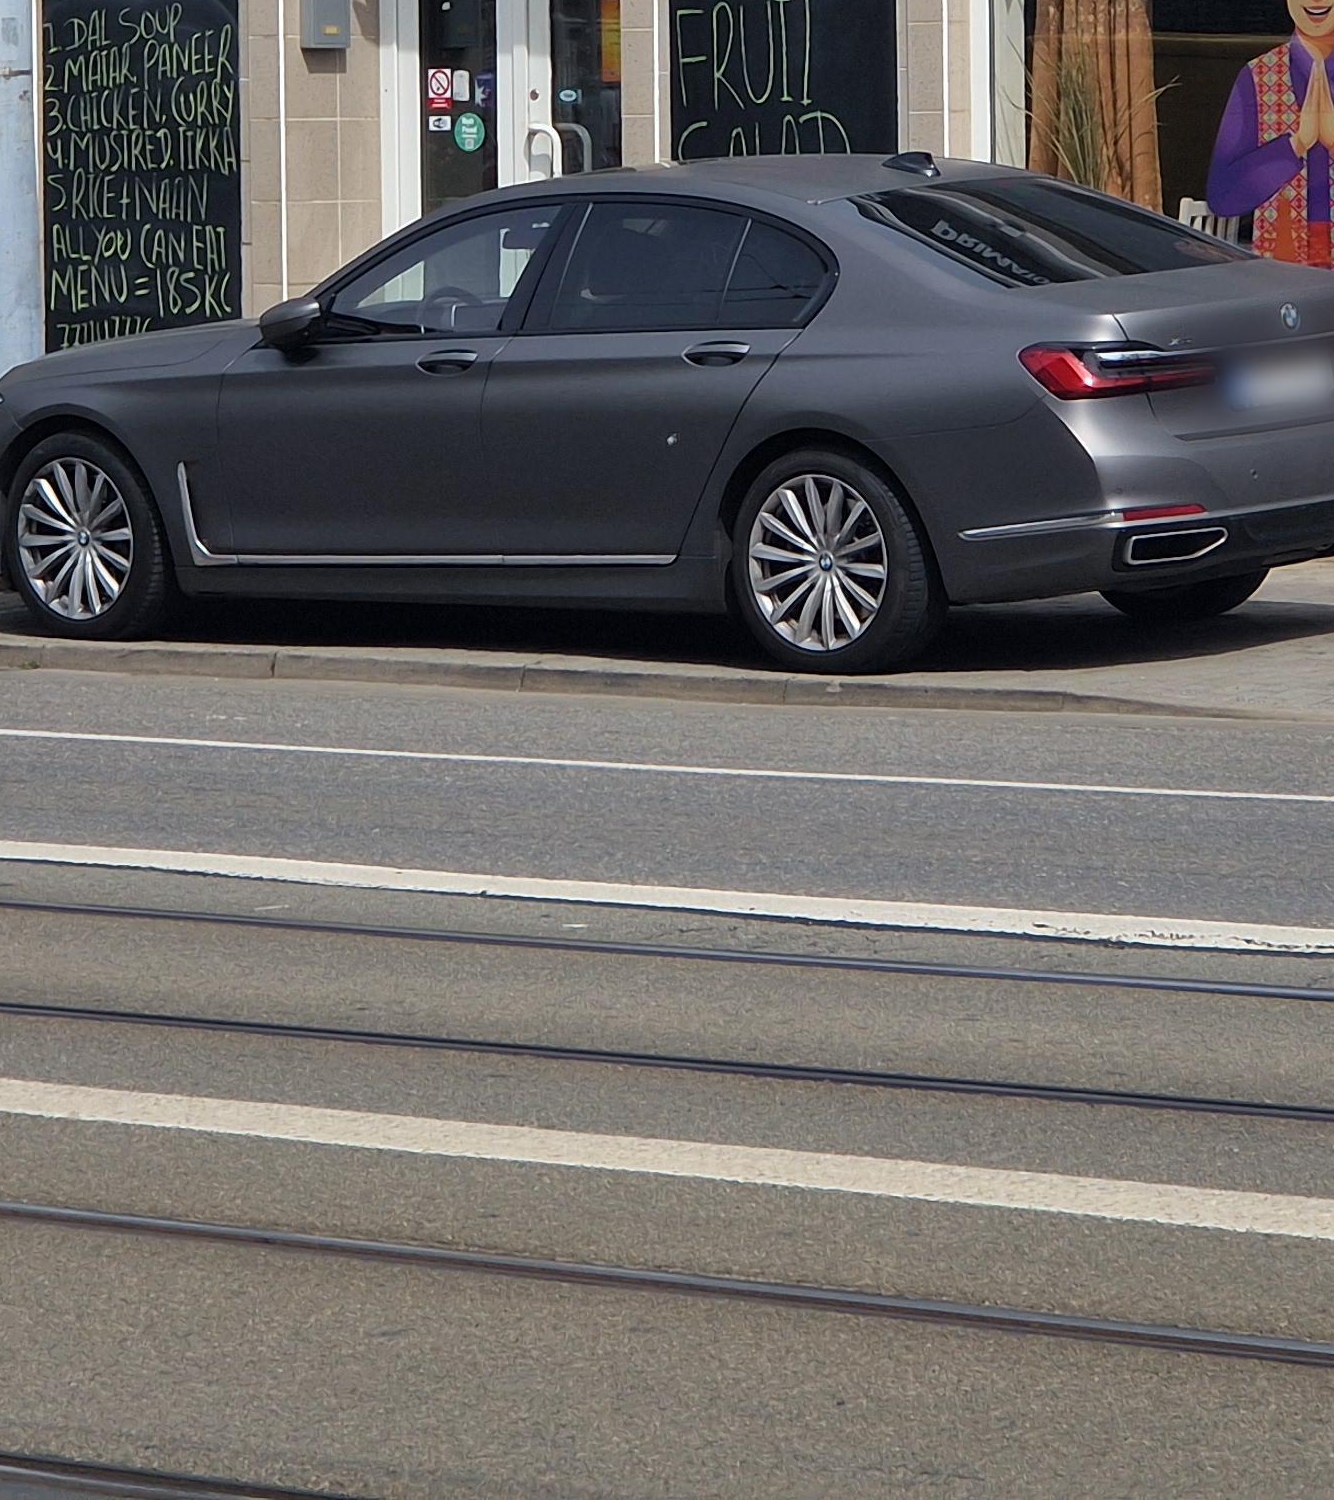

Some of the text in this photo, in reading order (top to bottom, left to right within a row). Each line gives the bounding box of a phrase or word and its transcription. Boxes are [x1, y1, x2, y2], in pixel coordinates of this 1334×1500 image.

[118, 2, 183, 45] SOUP
[143, 23, 234, 91] PANEER
[170, 76, 235, 127] CURRY
[178, 126, 237, 176] TIKKA
[140, 223, 185, 268] CAN
[192, 225, 226, 275] EAT
[50, 264, 128, 313] MENU
